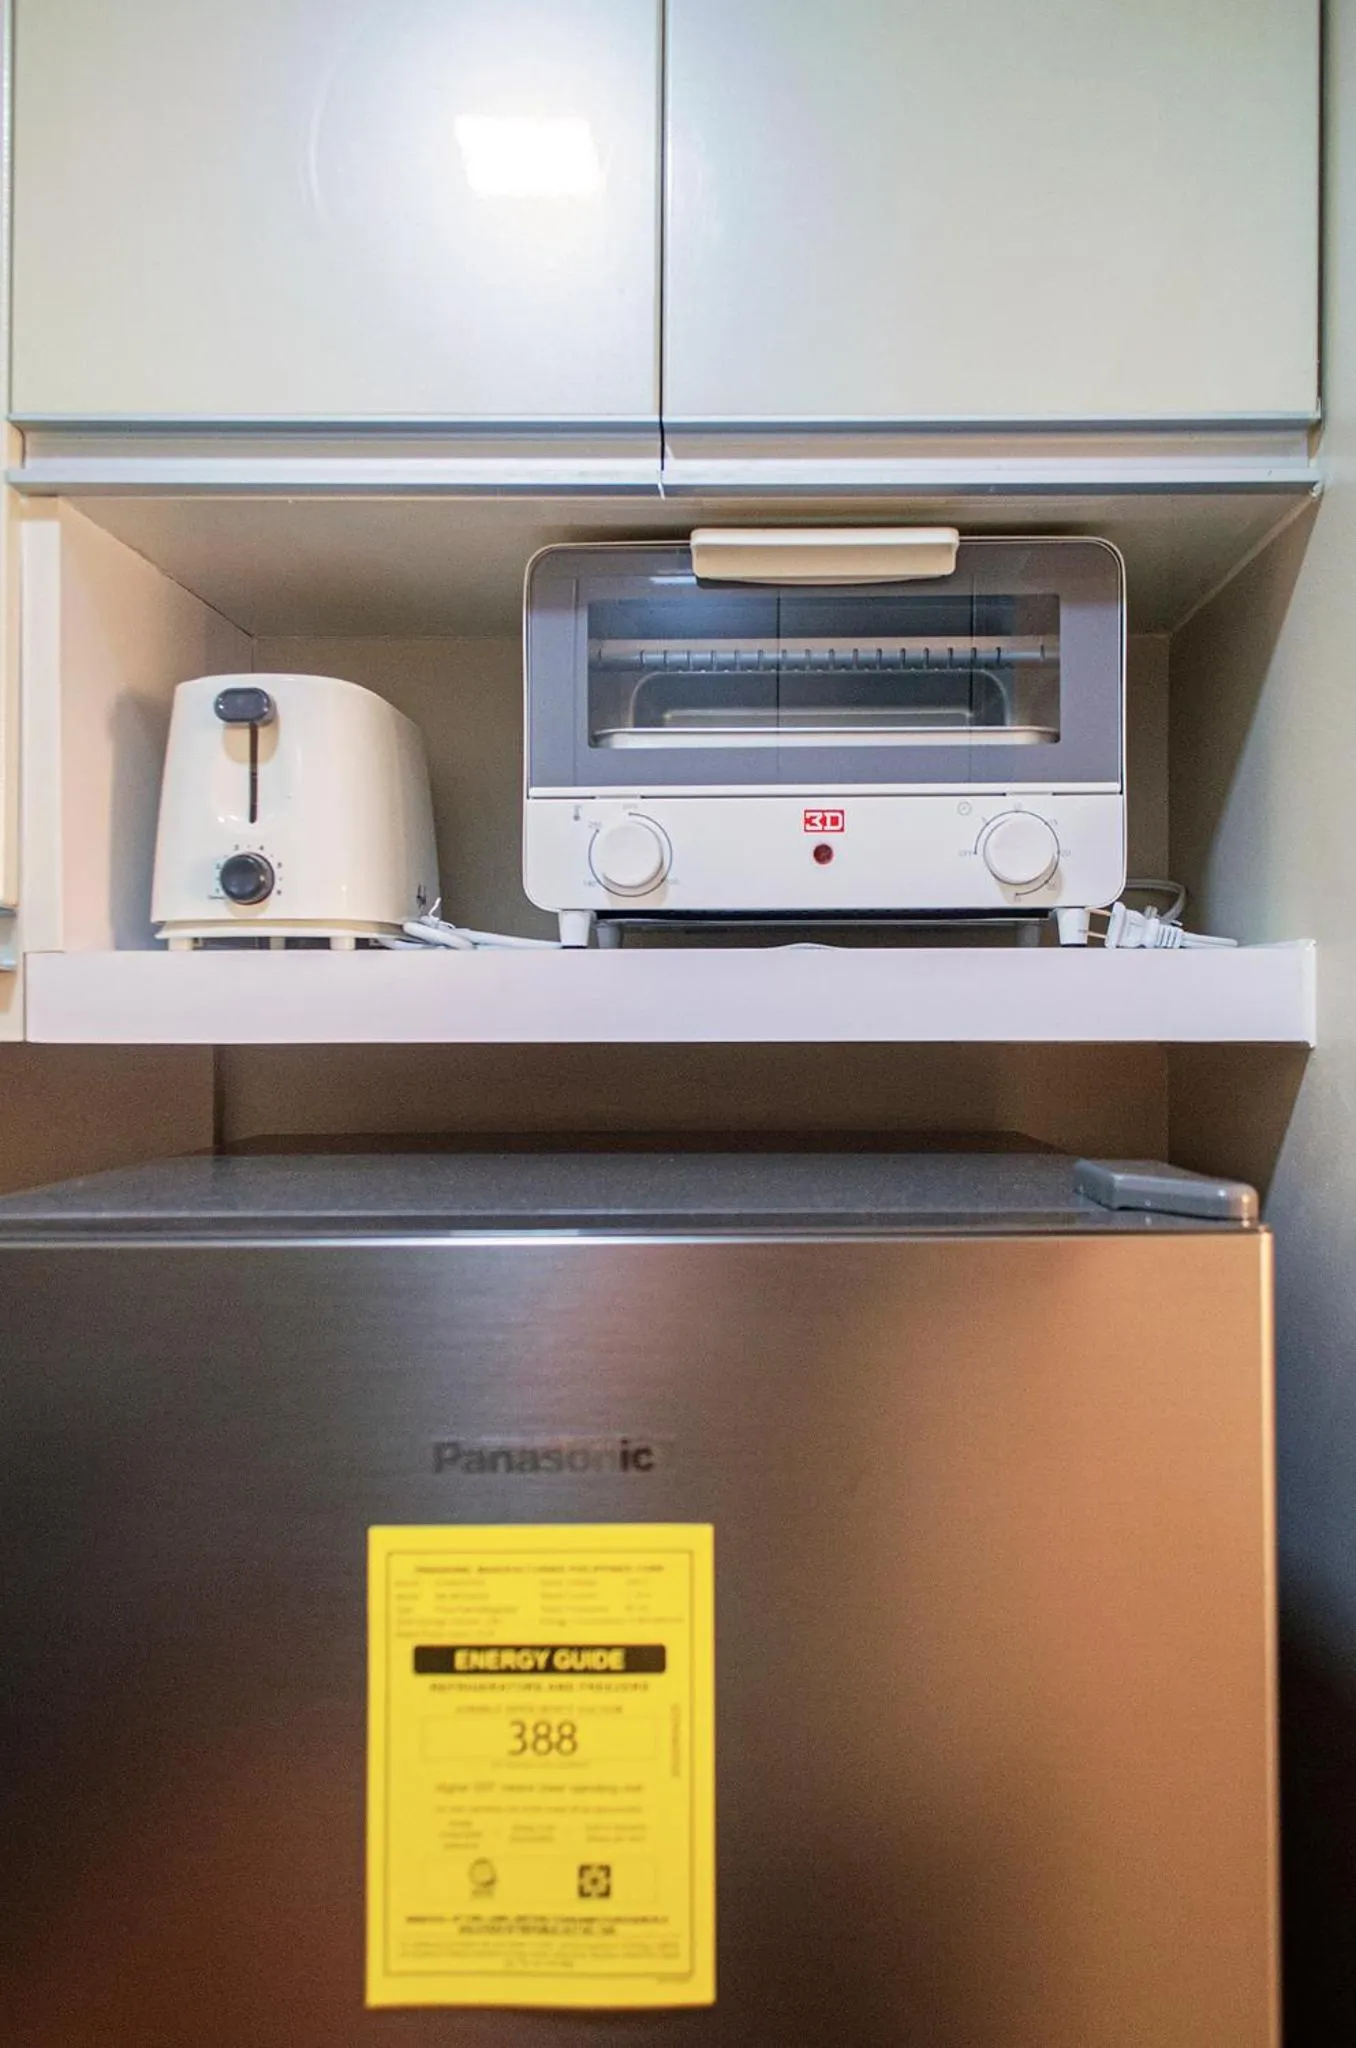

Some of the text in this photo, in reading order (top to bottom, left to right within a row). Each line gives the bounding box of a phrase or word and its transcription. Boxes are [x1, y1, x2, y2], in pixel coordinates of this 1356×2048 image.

[805, 811, 843, 831] 3D
[433, 1439, 654, 1474] Panasonic
[454, 1648, 626, 1671] ENERGY GUIDE
[508, 1719, 578, 1757] 388
